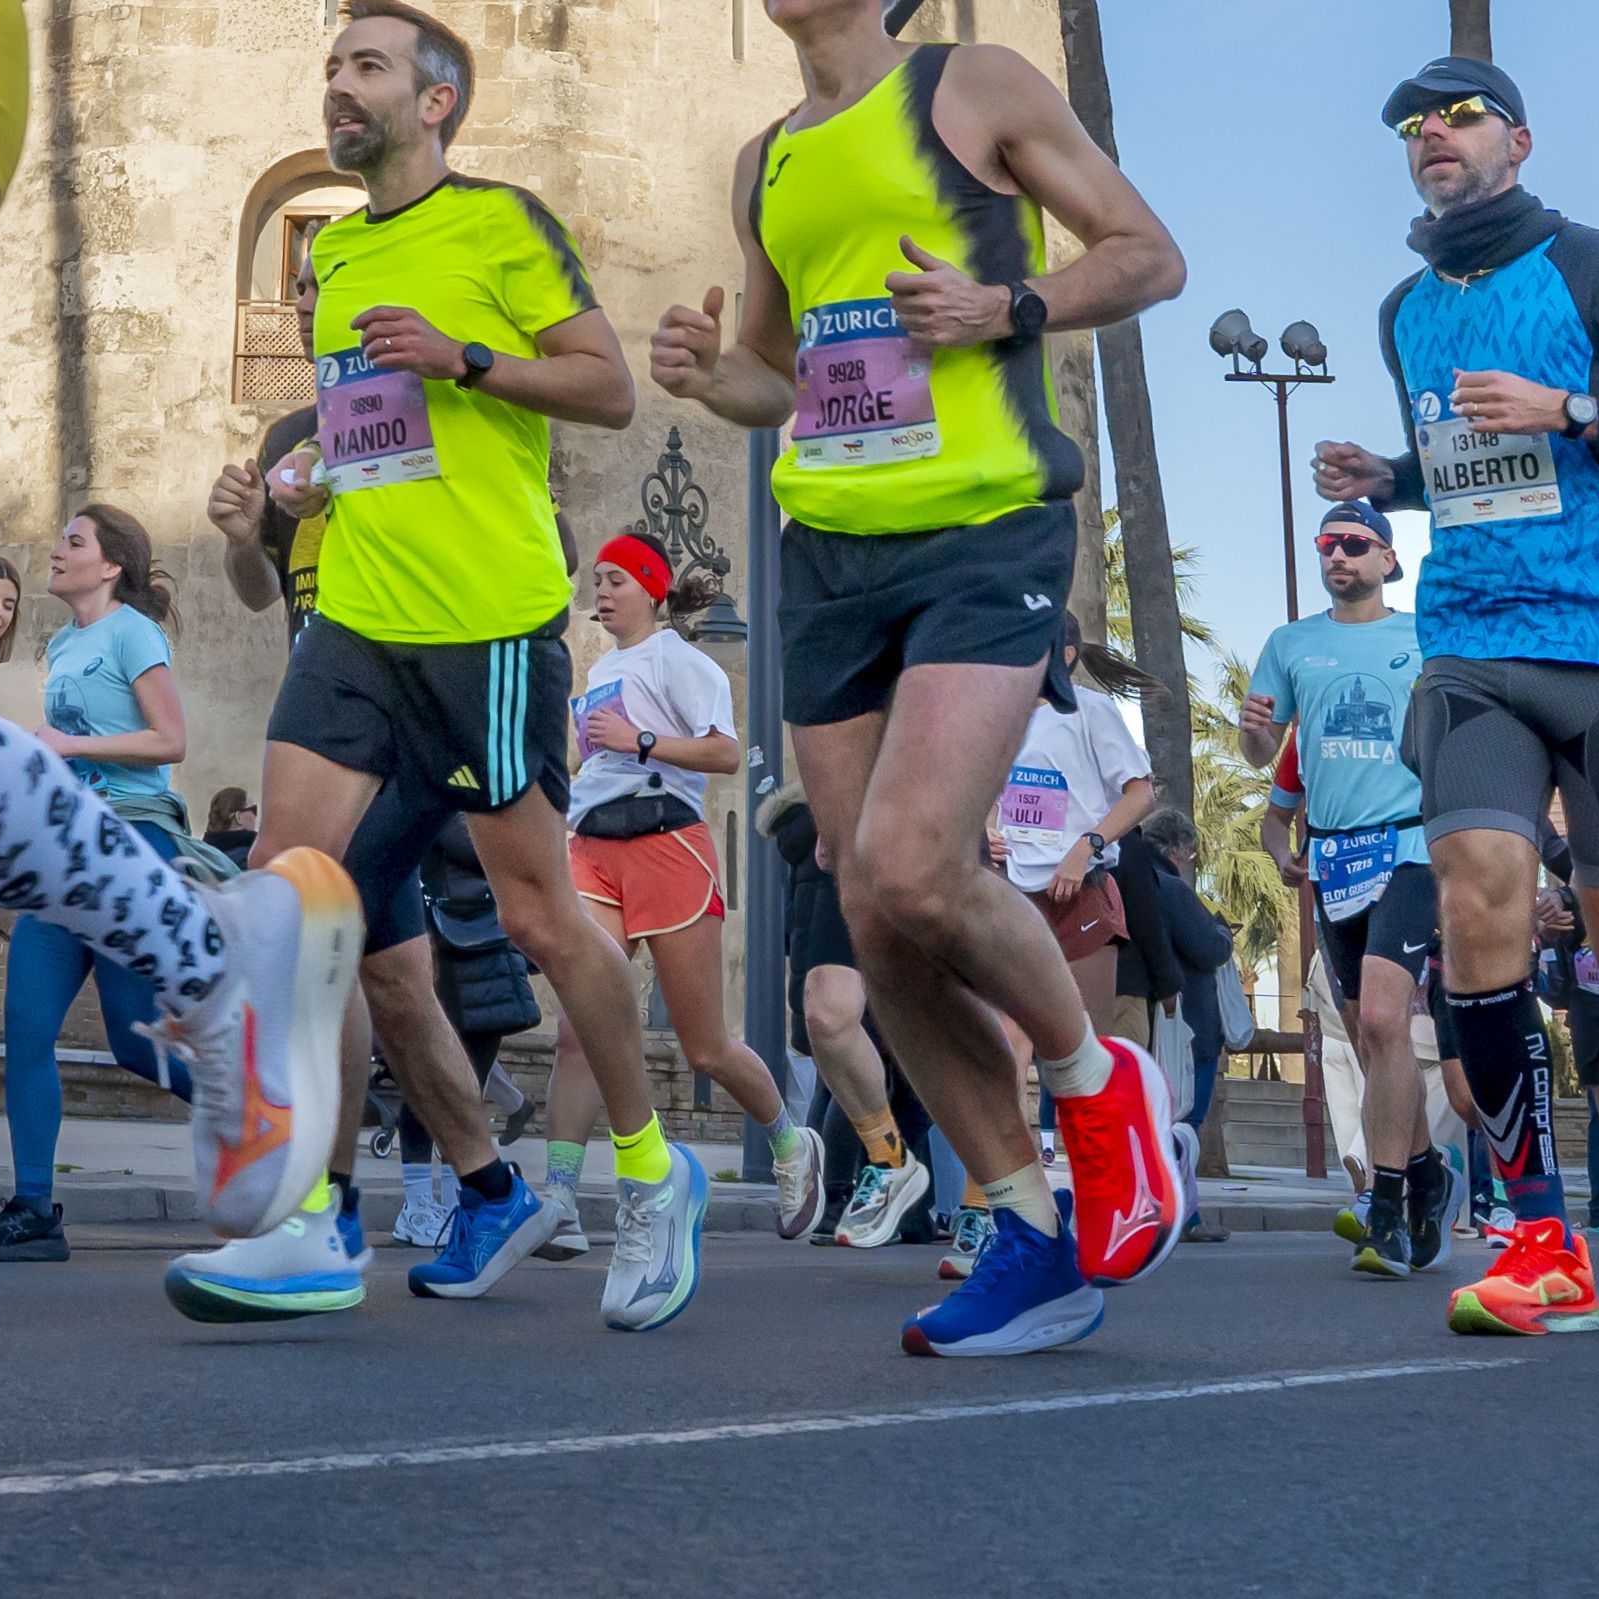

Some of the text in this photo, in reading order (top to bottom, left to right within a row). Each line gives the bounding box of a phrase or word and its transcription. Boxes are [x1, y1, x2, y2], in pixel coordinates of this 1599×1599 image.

[828, 360, 866, 384] 9928
[815, 390, 895, 430] JORGE
[334, 418, 407, 458] NANDO
[1452, 432, 1499, 453] 13148
[1433, 453, 1540, 493] ALBERTO
[1320, 741, 1395, 761] SEVILLA
[1016, 771, 1060, 786] ZURICH
[1343, 831, 1388, 850] ZURICH
[1322, 888, 1348, 903] ELOY
